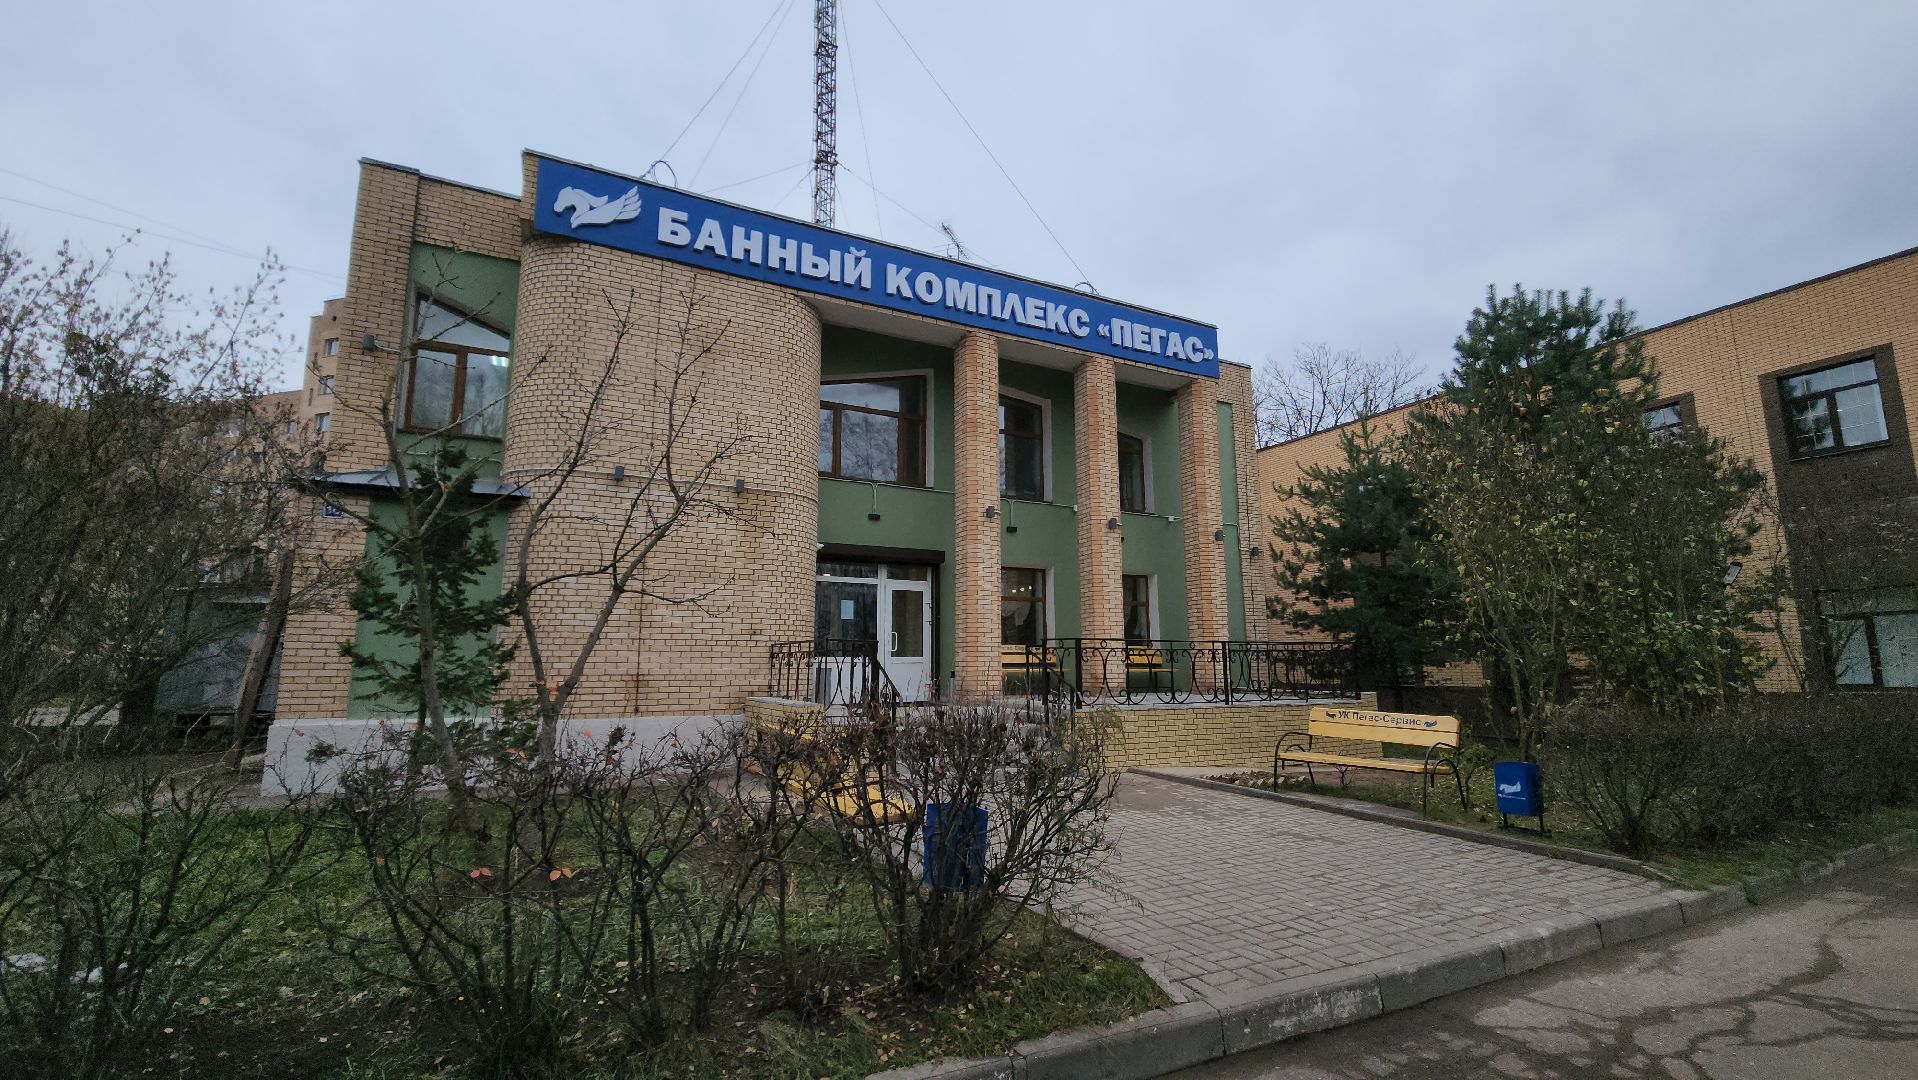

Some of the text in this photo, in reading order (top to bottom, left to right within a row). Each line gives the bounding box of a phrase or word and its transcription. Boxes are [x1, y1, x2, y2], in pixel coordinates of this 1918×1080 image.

[657, 206, 1215, 363] БАННЫЙ КОМПЛЕКС «ПЕГАС»
[1338, 711, 1421, 726] УК Пегас-Сервис
